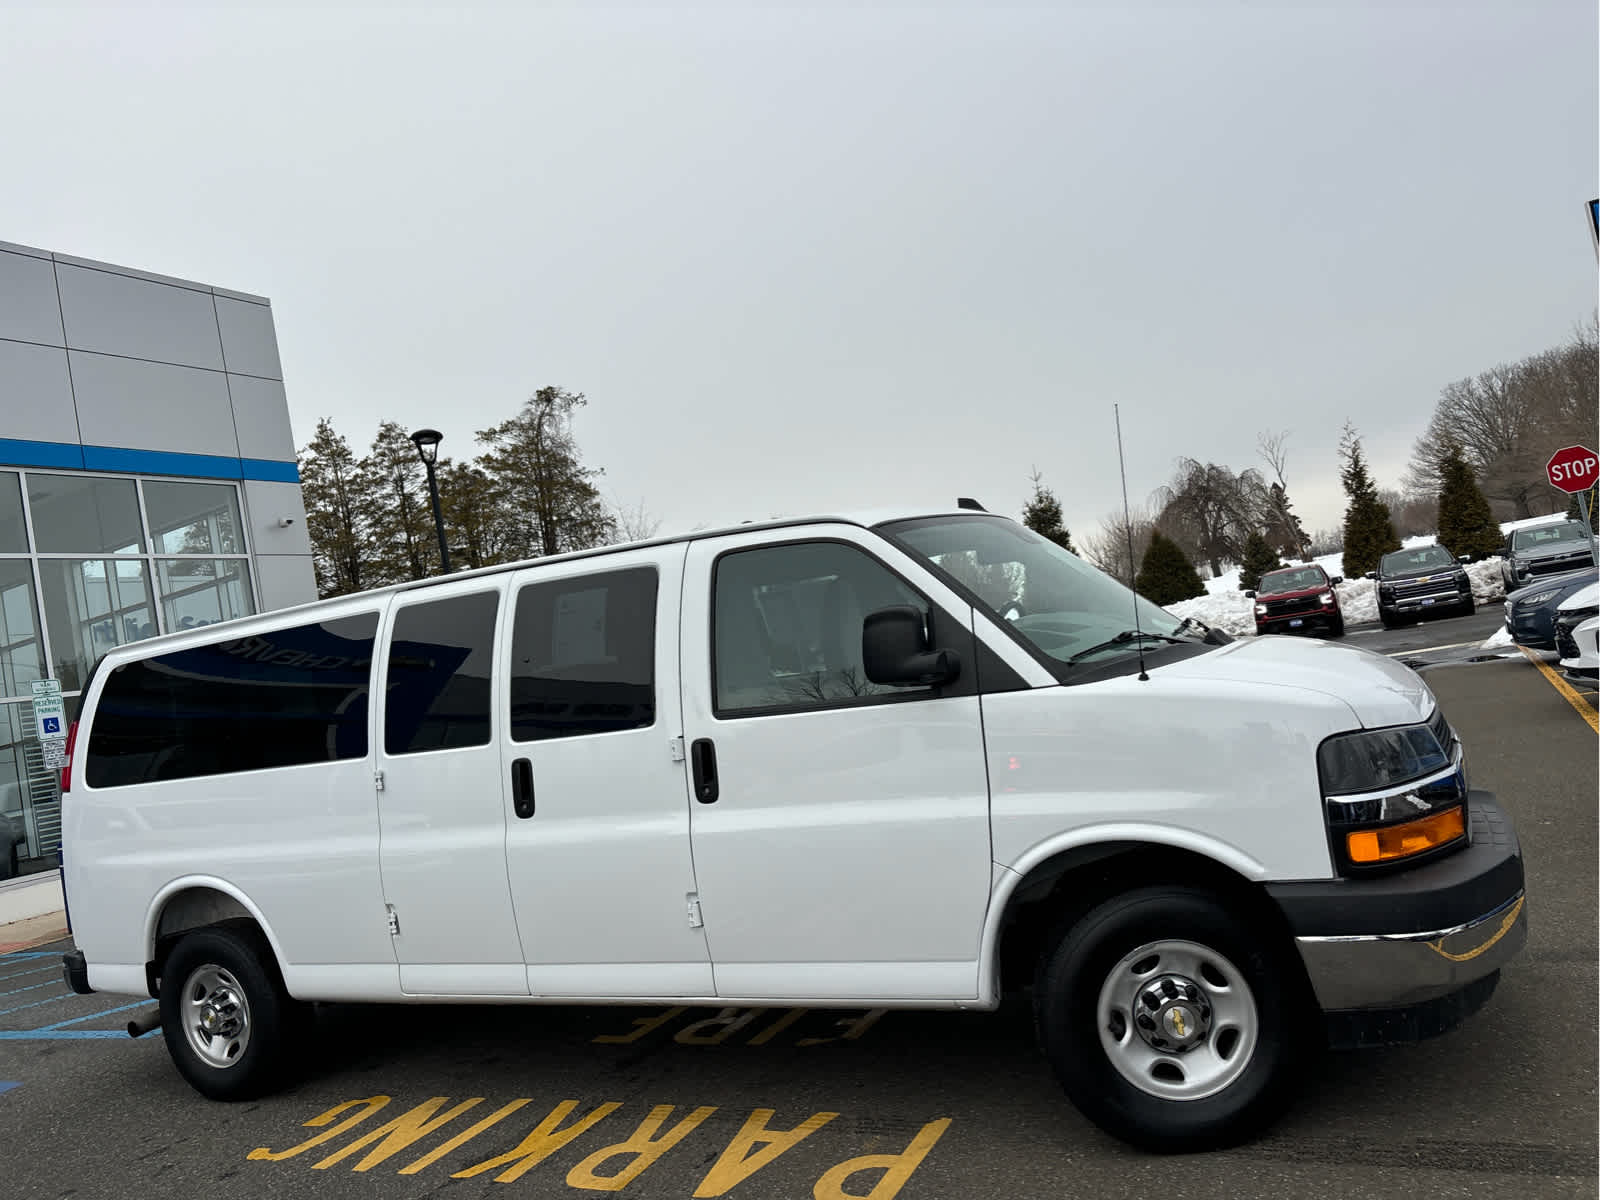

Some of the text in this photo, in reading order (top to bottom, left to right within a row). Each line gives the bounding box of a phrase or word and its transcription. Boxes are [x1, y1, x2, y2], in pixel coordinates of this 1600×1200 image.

[1551, 457, 1596, 481] STOP
[37, 705, 61, 713] PARKING
[246, 1094, 953, 1200] PARKING
